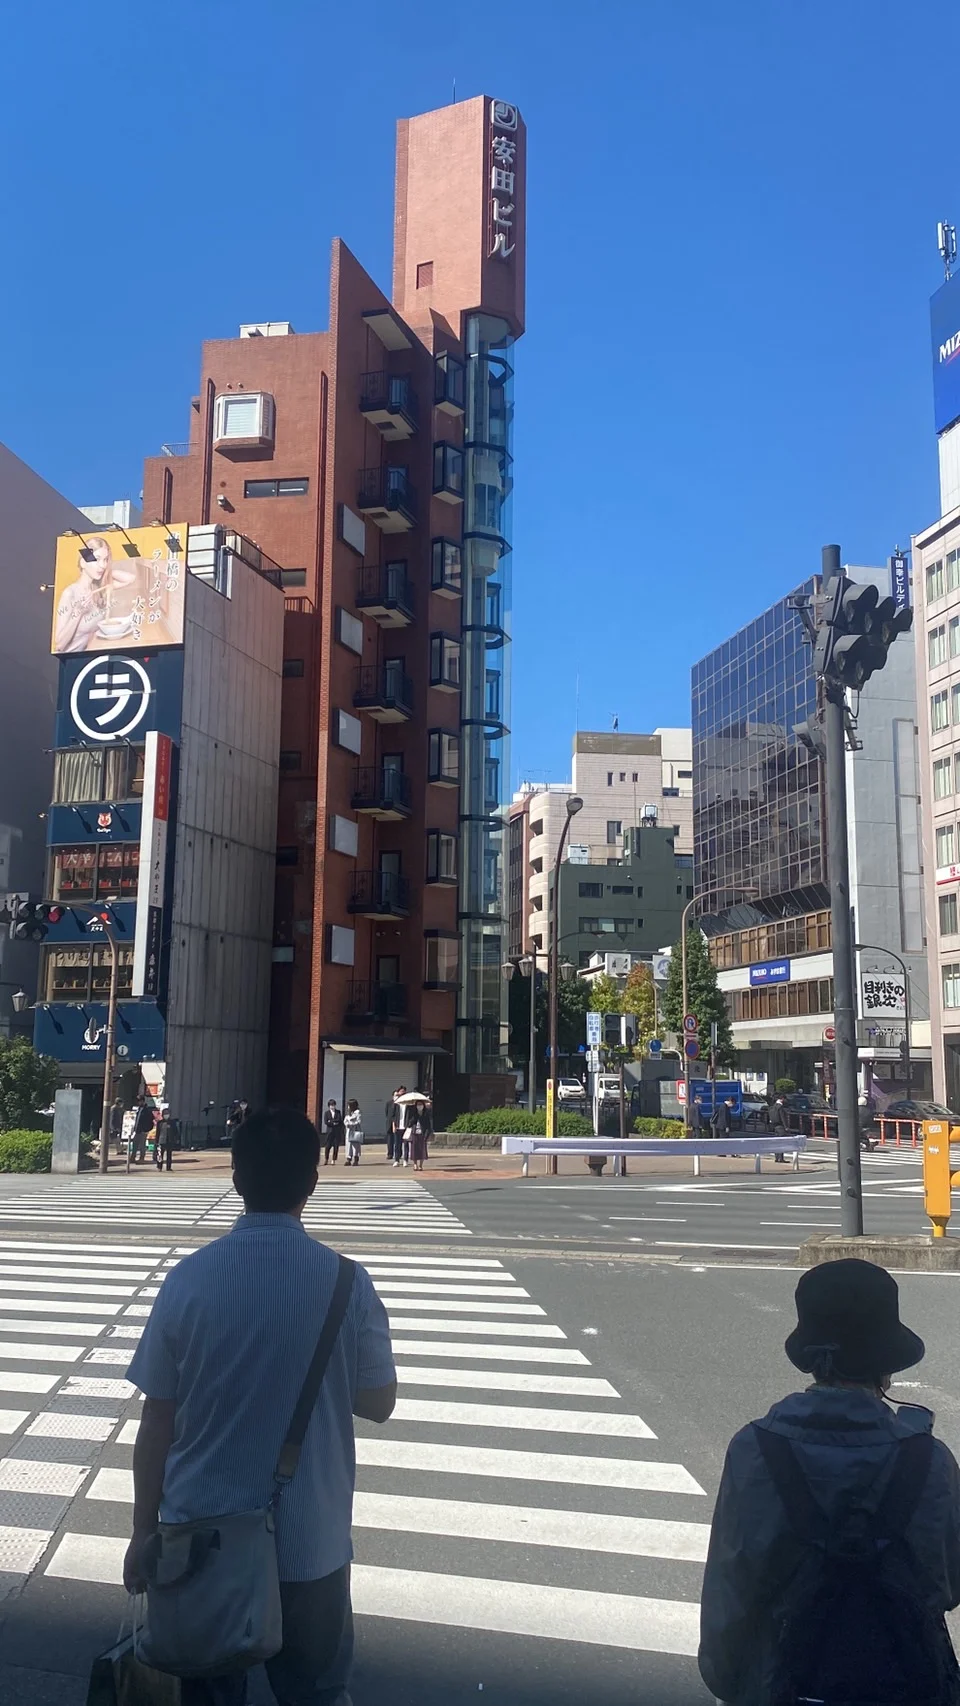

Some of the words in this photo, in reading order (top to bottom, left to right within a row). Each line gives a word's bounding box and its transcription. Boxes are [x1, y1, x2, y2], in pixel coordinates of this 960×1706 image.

[491, 135, 517, 258] 安田ビル
[148, 548, 162, 623] ラーメンが
[131, 595, 146, 641] 大好き
[863, 980, 905, 997] 目利きの
[864, 994, 897, 1009] 銀次
